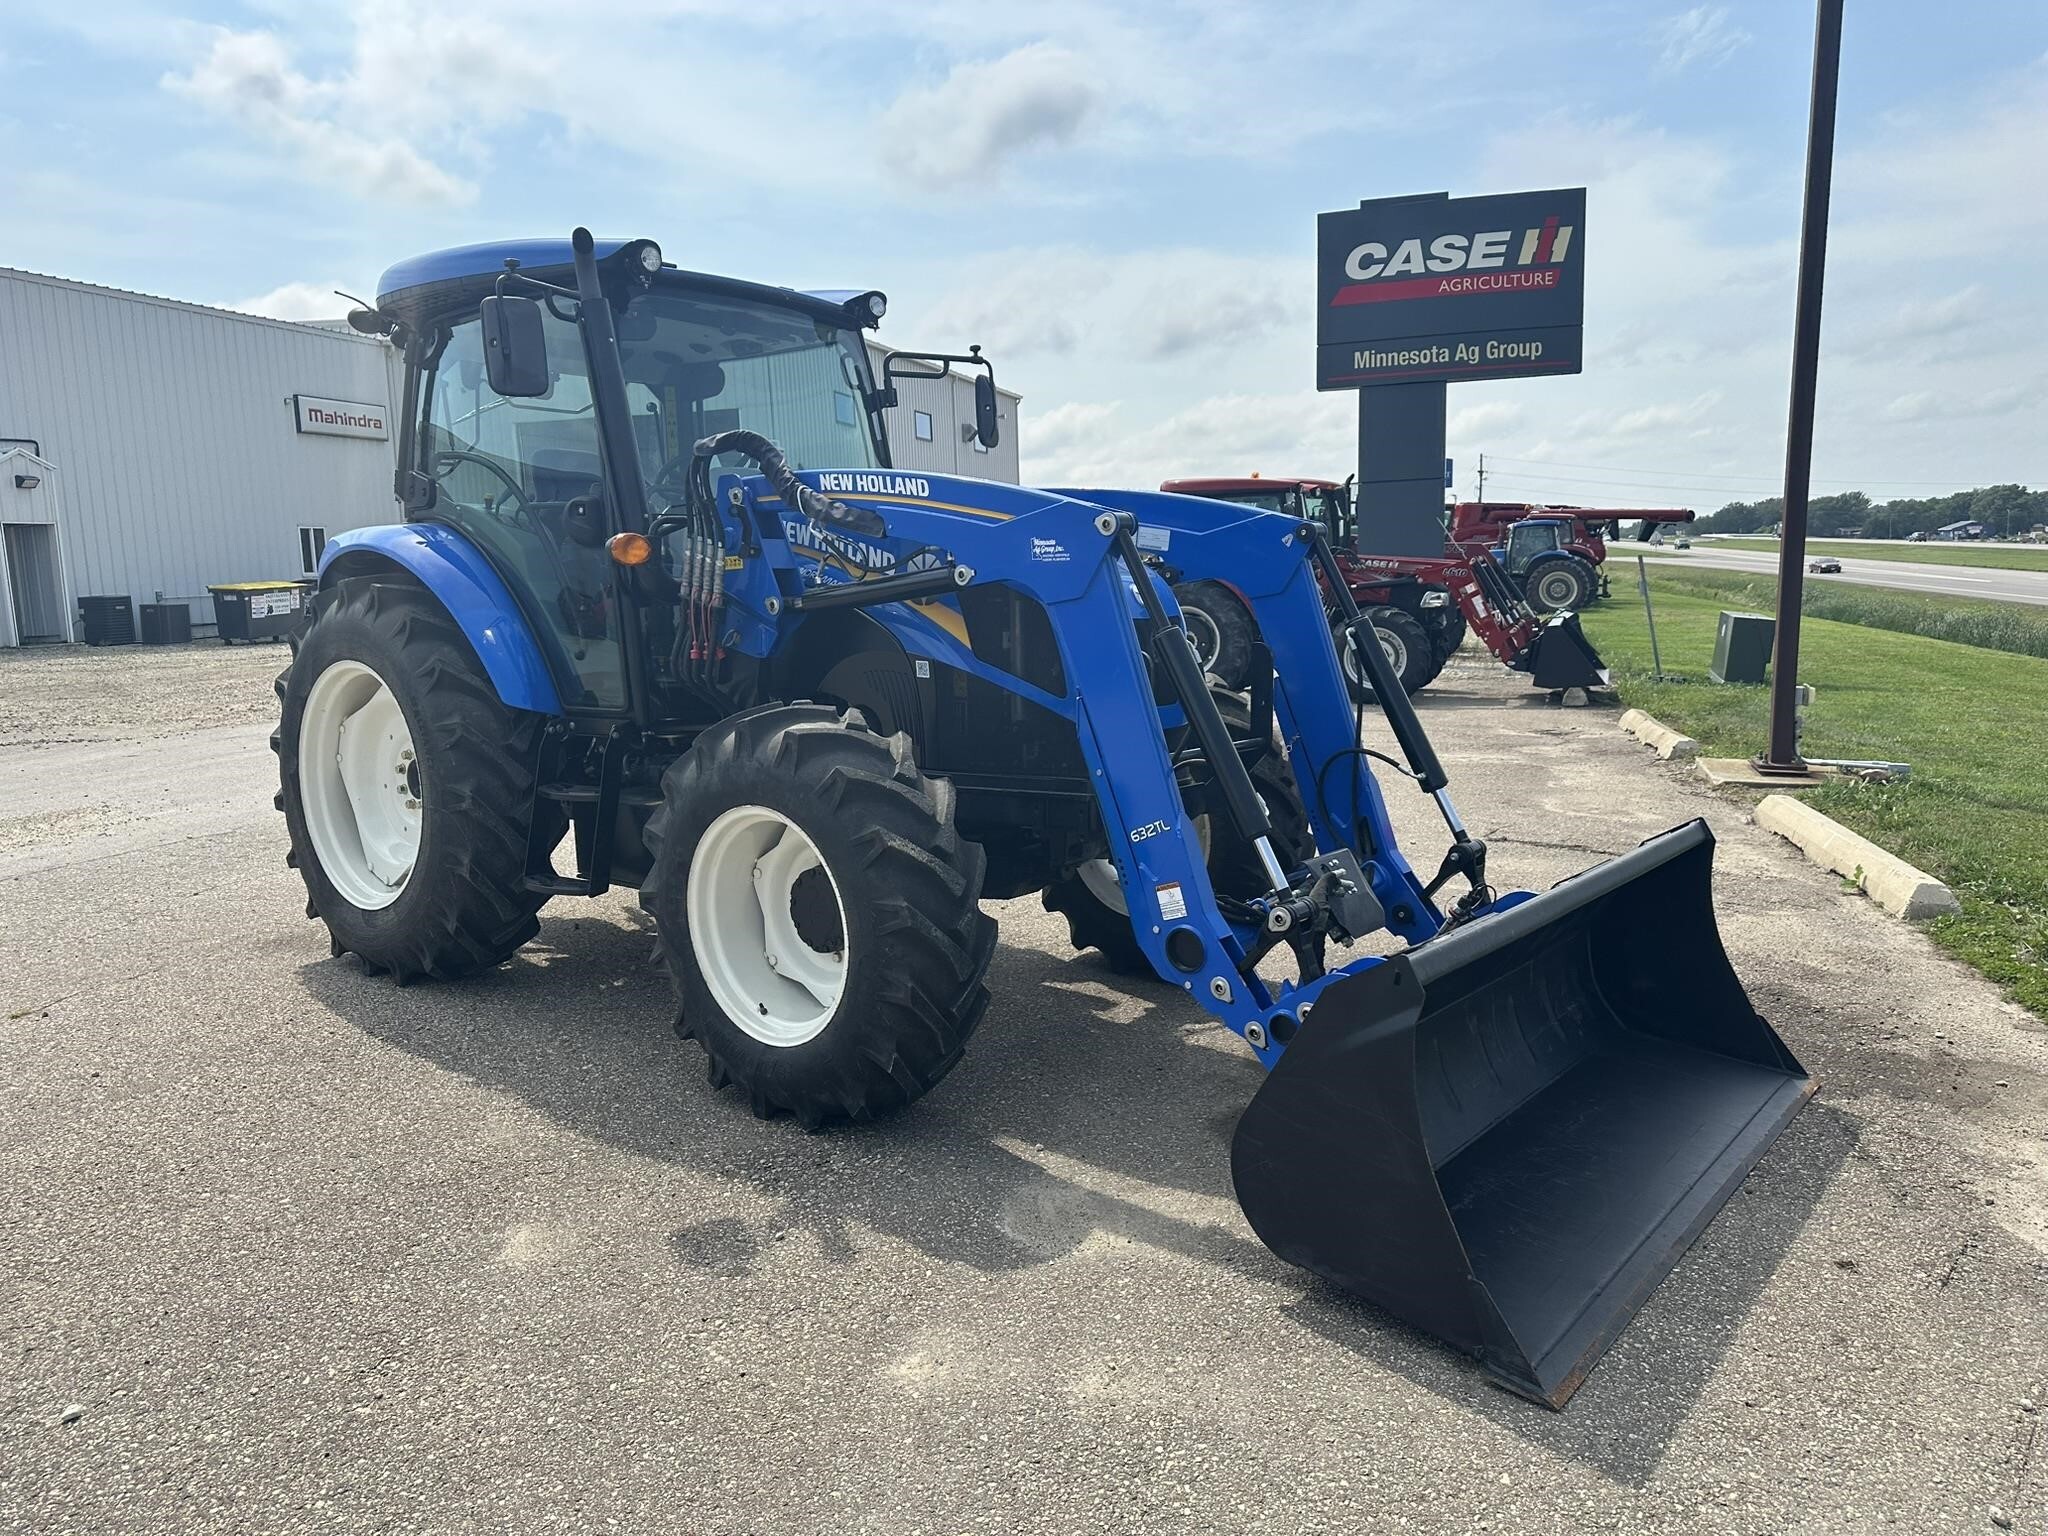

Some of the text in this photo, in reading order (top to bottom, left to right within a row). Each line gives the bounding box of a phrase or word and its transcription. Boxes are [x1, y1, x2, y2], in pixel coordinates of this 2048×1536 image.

[1344, 230, 1512, 280] CASE
[1438, 271, 1553, 293] AGRICULTURE
[1354, 340, 1542, 369] Minnesota Ag Group
[308, 408, 383, 429] Mahindra
[819, 473, 930, 497] NEW HOLLAND
[782, 520, 813, 546] EW
[1130, 819, 1171, 842] 632TL
